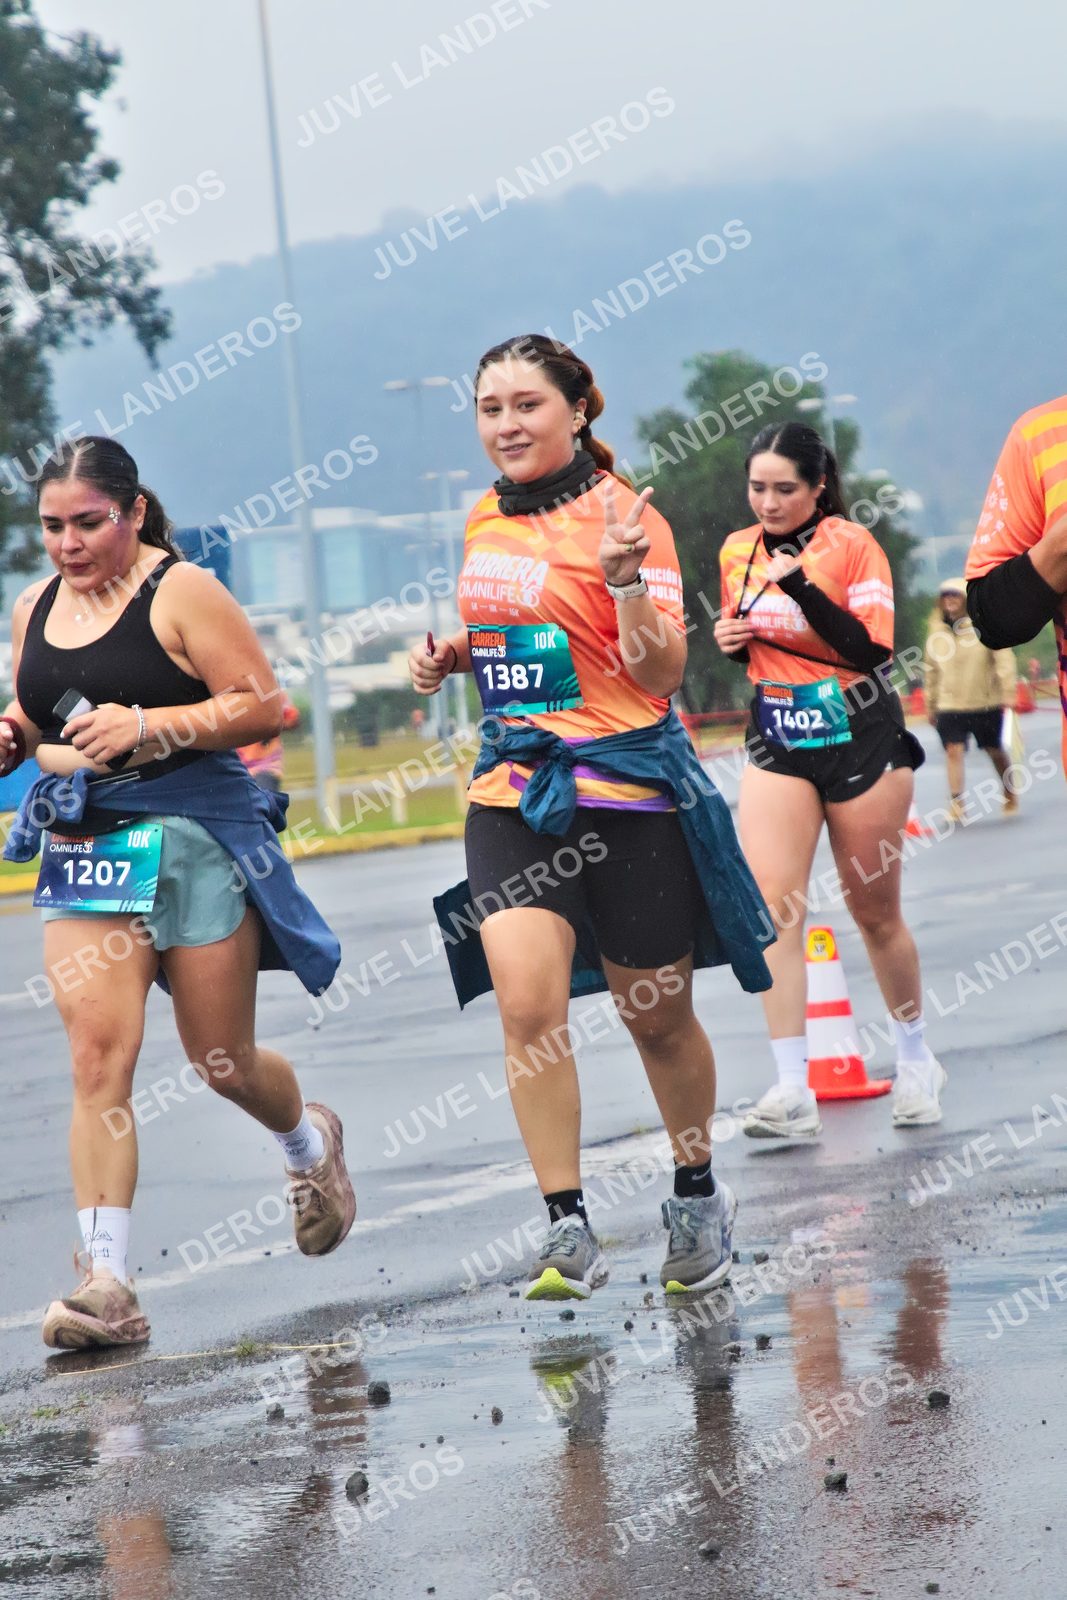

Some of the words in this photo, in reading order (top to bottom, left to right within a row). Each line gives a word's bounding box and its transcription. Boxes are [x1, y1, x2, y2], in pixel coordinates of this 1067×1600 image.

[463, 551, 549, 586] CARRERA
[471, 632, 506, 646] CARRERA
[533, 631, 557, 650] 10K
[482, 663, 544, 690] 1387
[818, 682, 834, 699] 10K
[772, 708, 825, 730] 1402
[127, 830, 152, 848] 10K
[63, 859, 131, 886] 1207
